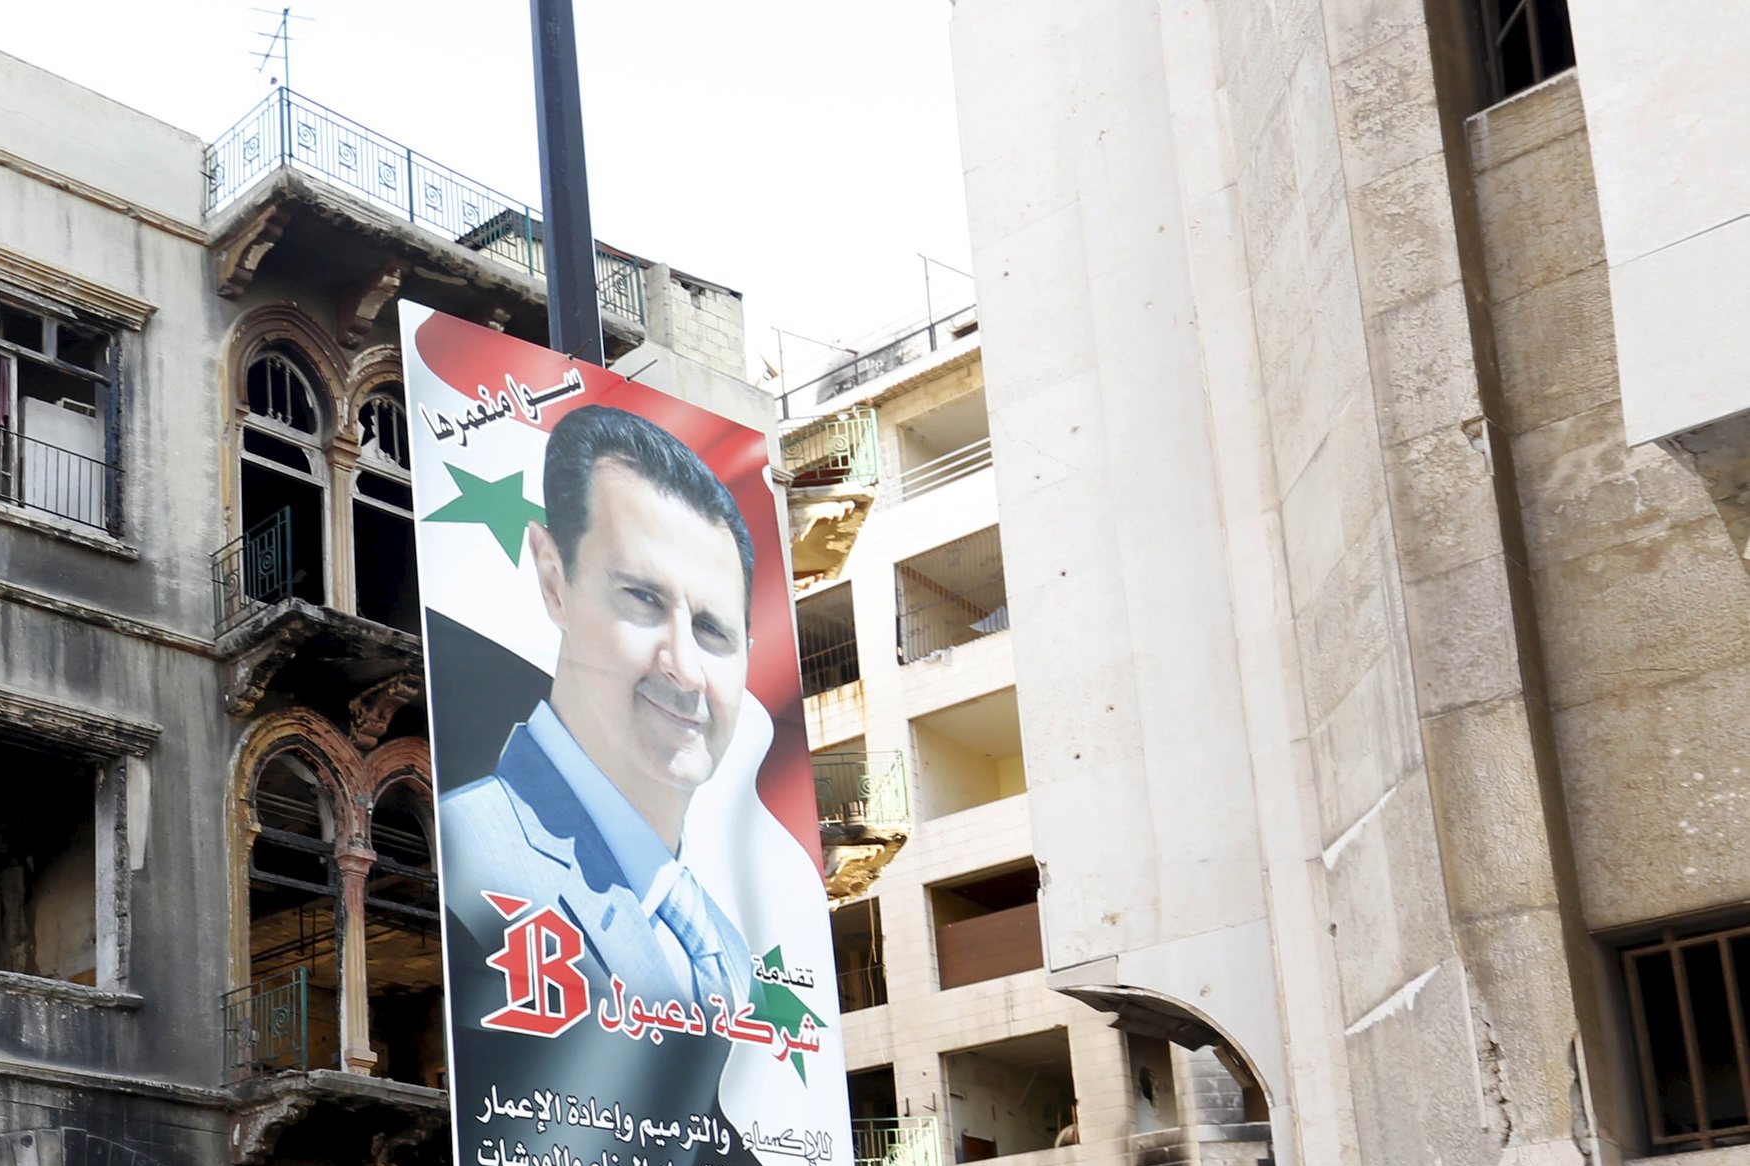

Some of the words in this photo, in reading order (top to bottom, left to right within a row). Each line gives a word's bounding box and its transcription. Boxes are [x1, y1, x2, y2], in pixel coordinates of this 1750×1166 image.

[418, 384, 516, 448] منعمرها
[752, 953, 815, 990] تقدمة
[598, 975, 708, 1045] دعبول
[710, 994, 821, 1062] شركة
[475, 1083, 562, 1134] الإعمار
[565, 1095, 634, 1143] وإعادة
[639, 1114, 732, 1156] والترميم
